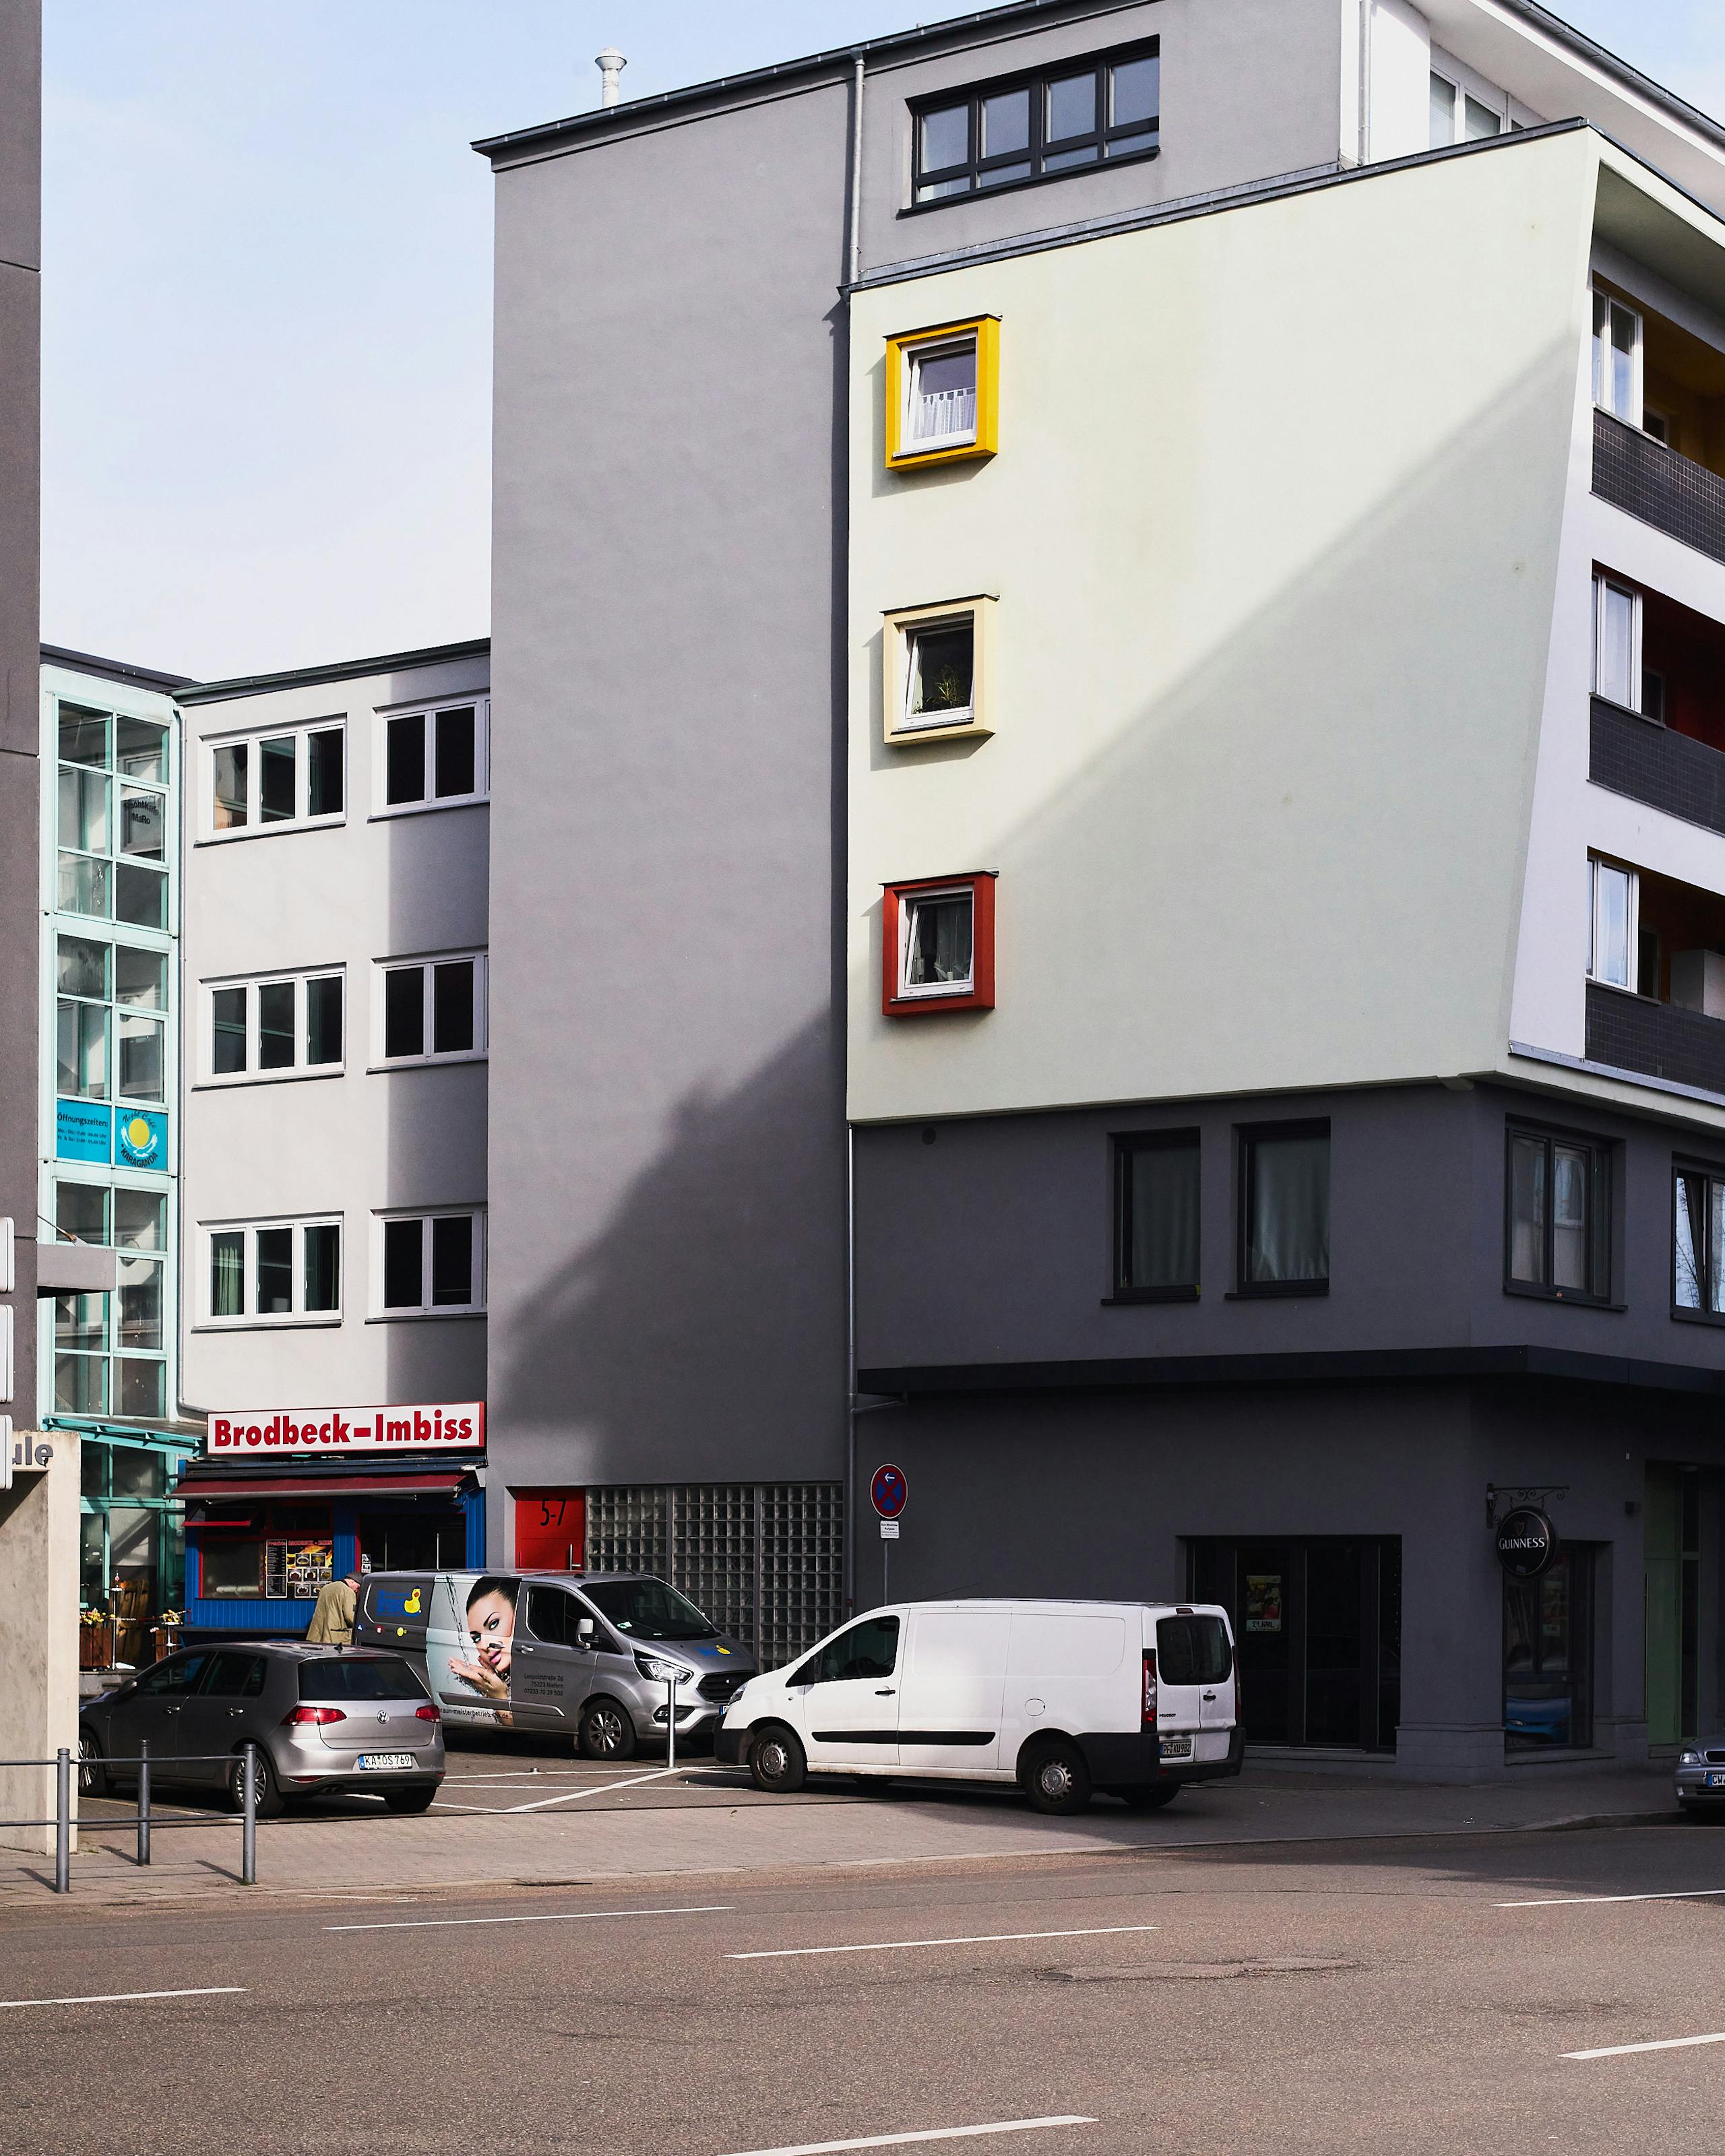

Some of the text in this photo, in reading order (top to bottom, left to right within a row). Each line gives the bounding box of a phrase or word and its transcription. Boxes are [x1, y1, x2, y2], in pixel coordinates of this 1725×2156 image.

[57, 1112, 108, 1127] Öffnungszeiten:
[123, 1111, 139, 1124] Night
[121, 1148, 158, 1168] KARAGANDA
[214, 1409, 472, 1447] Brodbeck-Imbiss
[540, 1498, 567, 1526] 5-7
[1499, 1537, 1545, 1550] GUINNESS
[1173, 1744, 1181, 1753] KU
[365, 1754, 410, 1765] KA OS 769
[1712, 1775, 1722, 1784] CW
